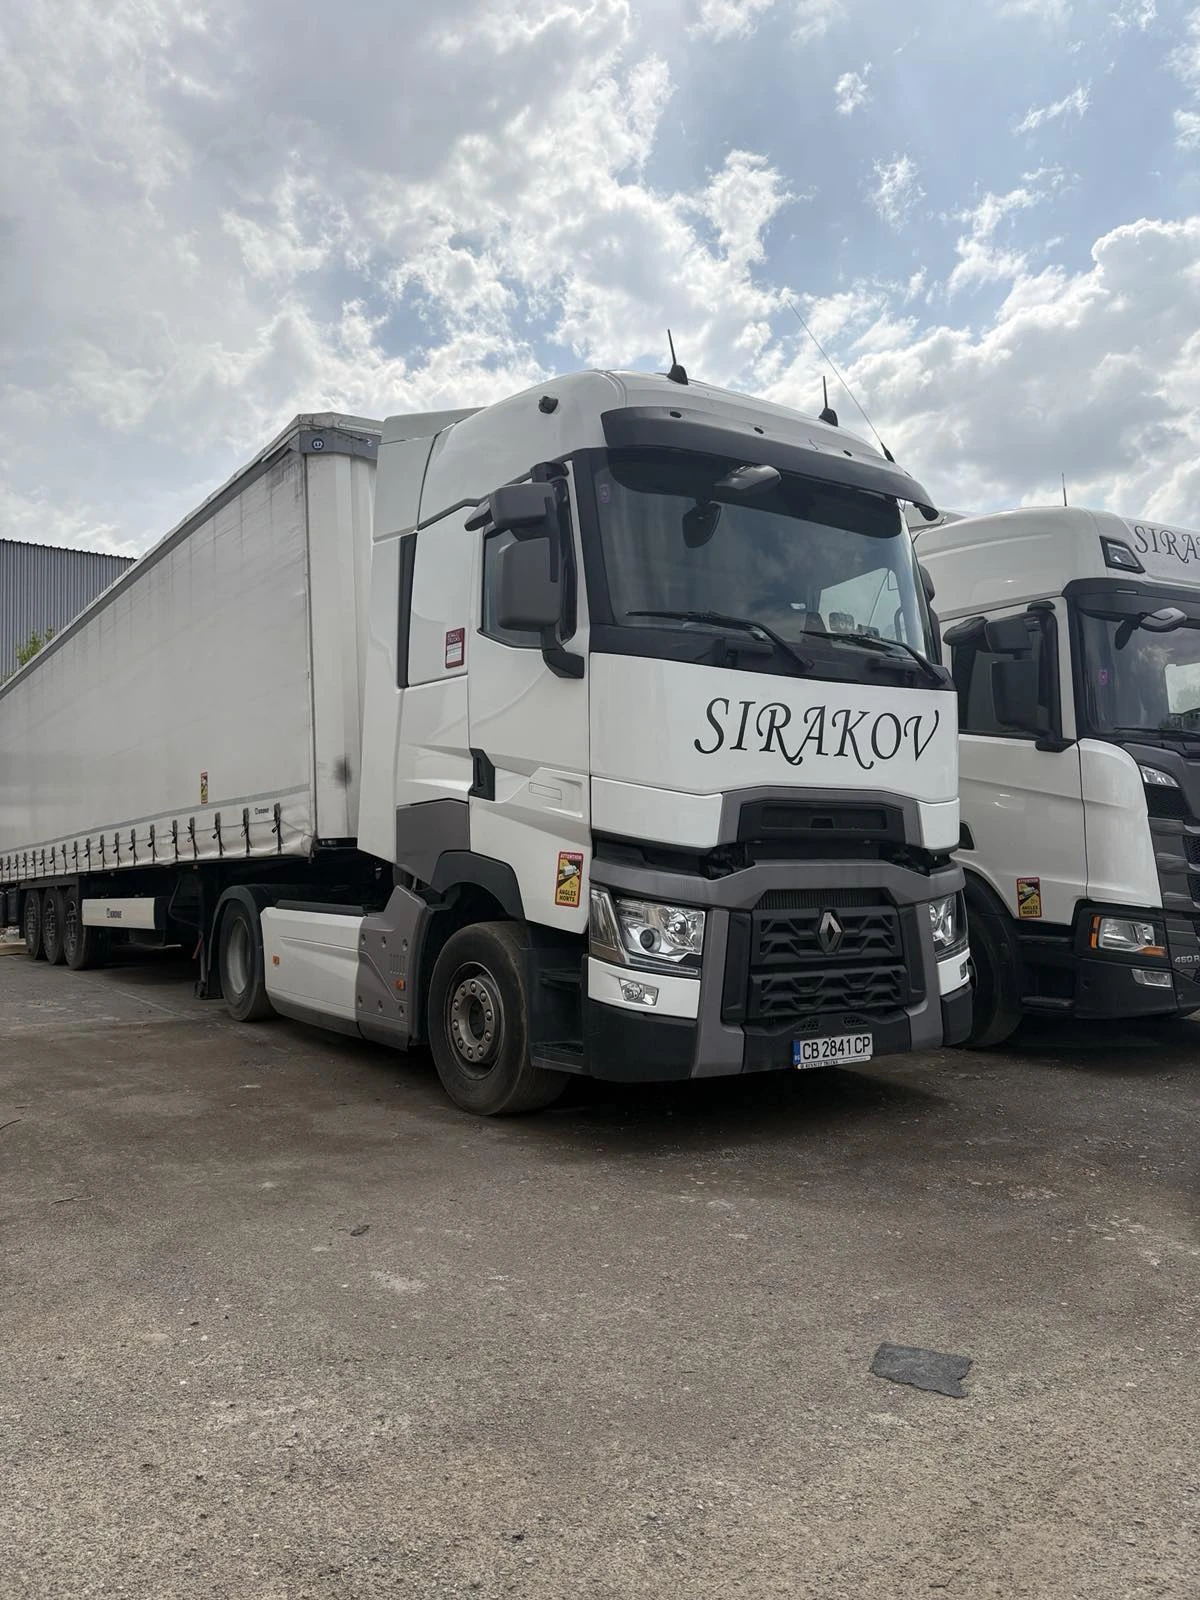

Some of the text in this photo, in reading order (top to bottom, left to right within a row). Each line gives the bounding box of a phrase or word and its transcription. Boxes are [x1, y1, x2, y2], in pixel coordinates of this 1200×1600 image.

[1134, 525, 1200, 564] SIRA
[694, 697, 940, 770] SIRAKOV
[1174, 955, 1193, 963] 460
[802, 1036, 871, 1060] CB 2841 CP
